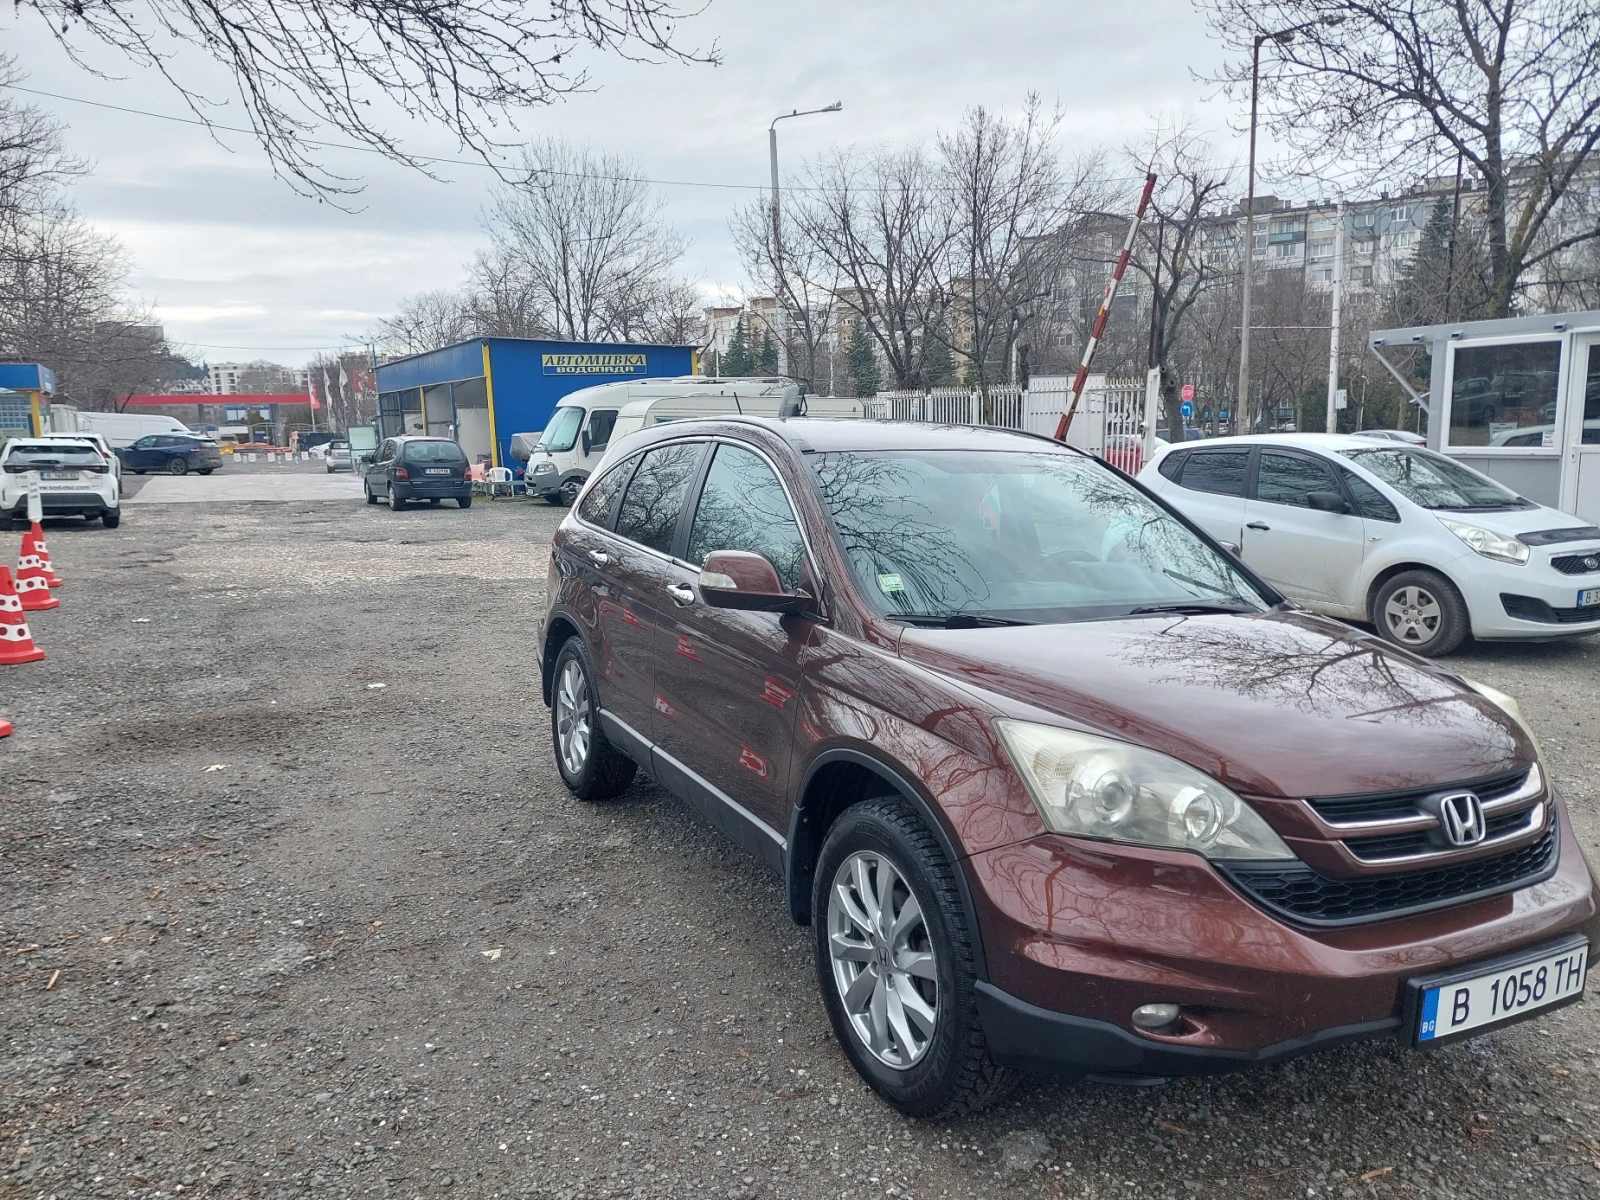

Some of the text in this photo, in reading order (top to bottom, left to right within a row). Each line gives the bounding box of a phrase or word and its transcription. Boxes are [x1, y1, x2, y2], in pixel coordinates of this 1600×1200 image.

[544, 355, 644, 366] АВТОМИВКА
[556, 366, 635, 374] ВОДОПАДА
[1585, 592, 1592, 604] B
[1451, 952, 1583, 1026] B 1058 TH
[1421, 1020, 1435, 1034] BG
